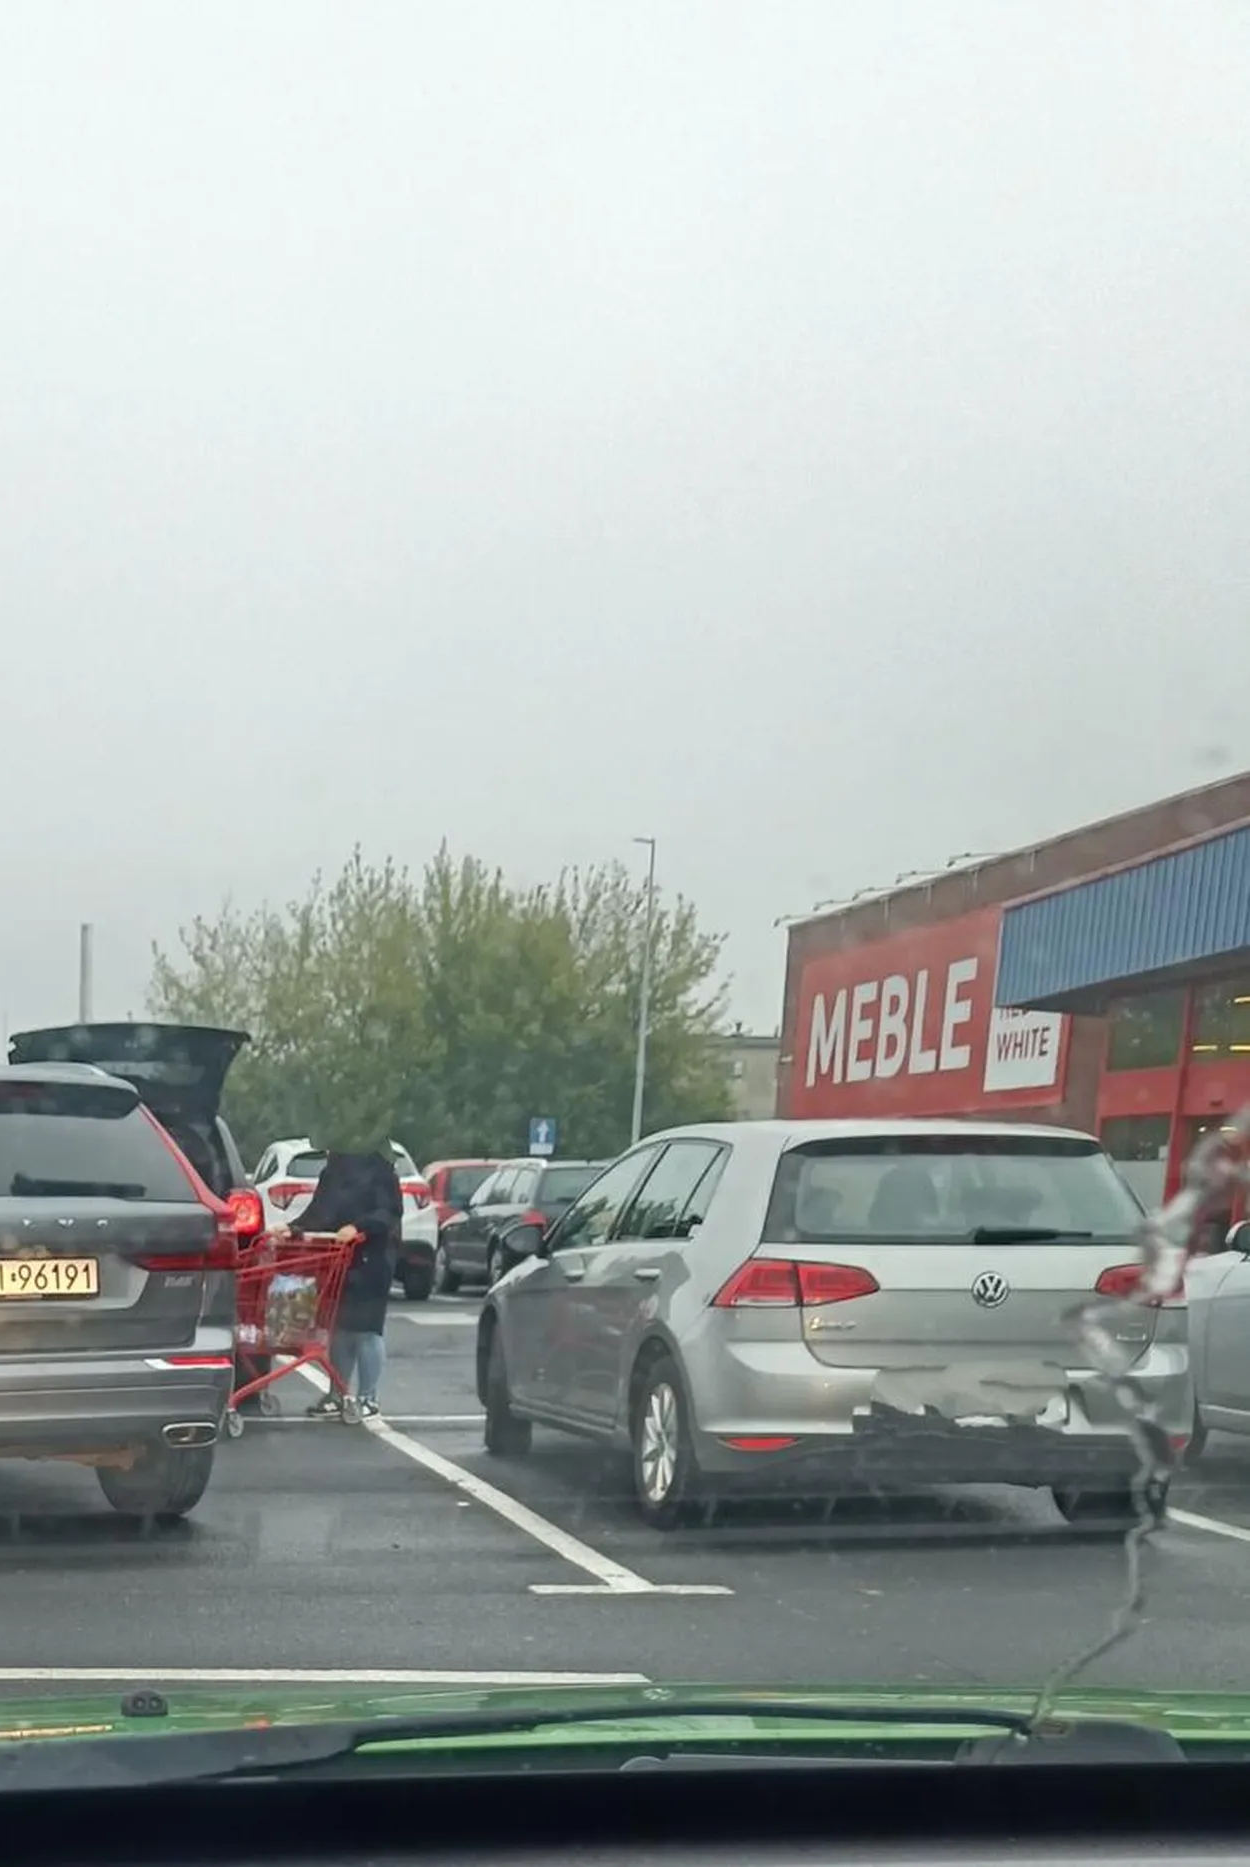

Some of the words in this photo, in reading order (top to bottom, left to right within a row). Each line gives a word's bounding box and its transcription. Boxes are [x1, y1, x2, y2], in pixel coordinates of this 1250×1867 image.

[805, 956, 979, 1089] MEBLE
[996, 1026, 1052, 1063] WHITE
[17, 1262, 92, 1292] 96191
